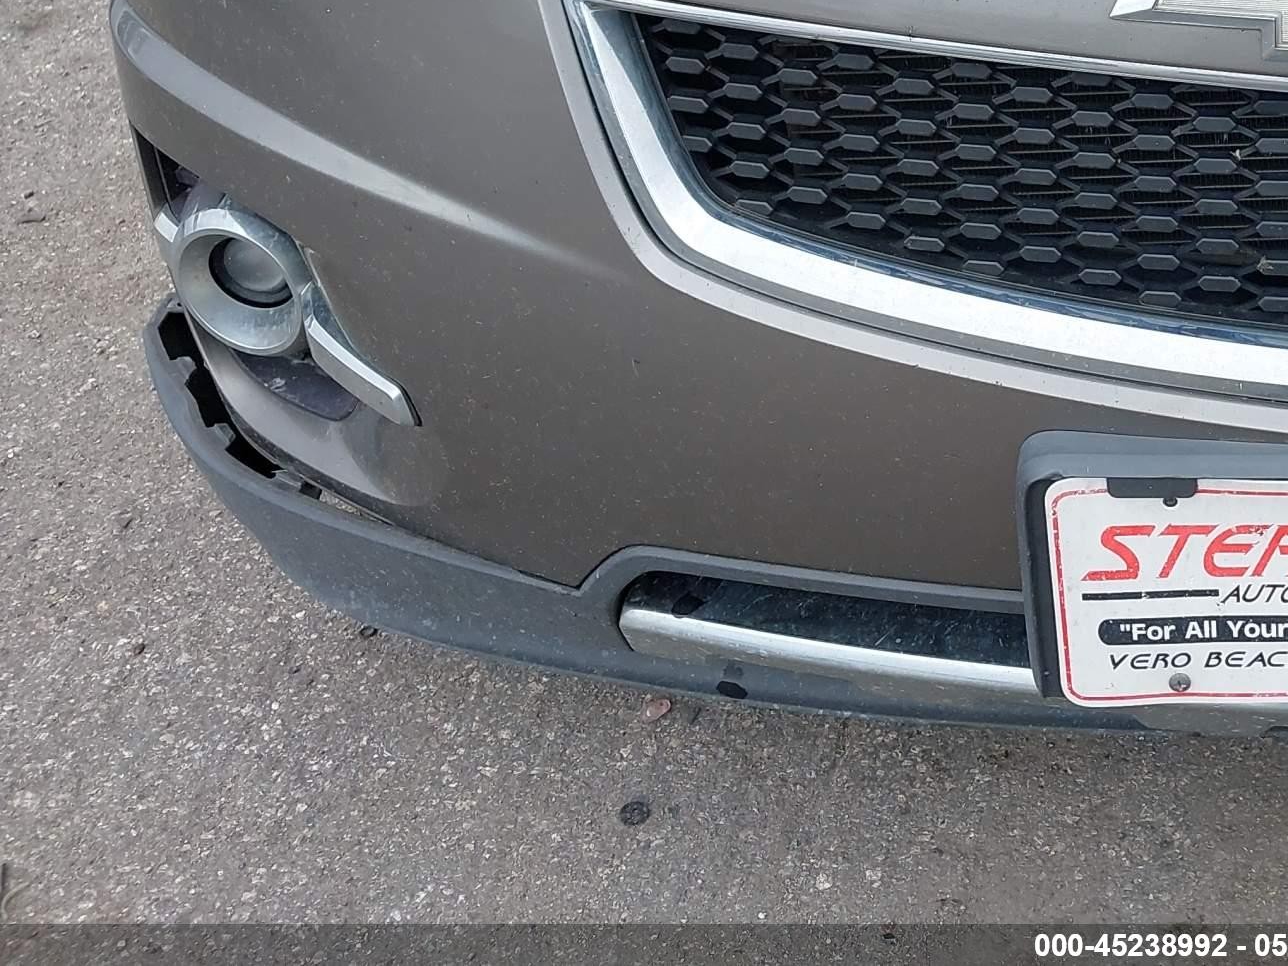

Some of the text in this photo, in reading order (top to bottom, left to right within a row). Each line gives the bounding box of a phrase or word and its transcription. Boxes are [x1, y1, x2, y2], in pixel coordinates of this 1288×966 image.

[1120, 622, 1176, 642] "For
[1184, 620, 1217, 640] All
[1228, 619, 1288, 639] Your
[1109, 652, 1192, 670] VERO
